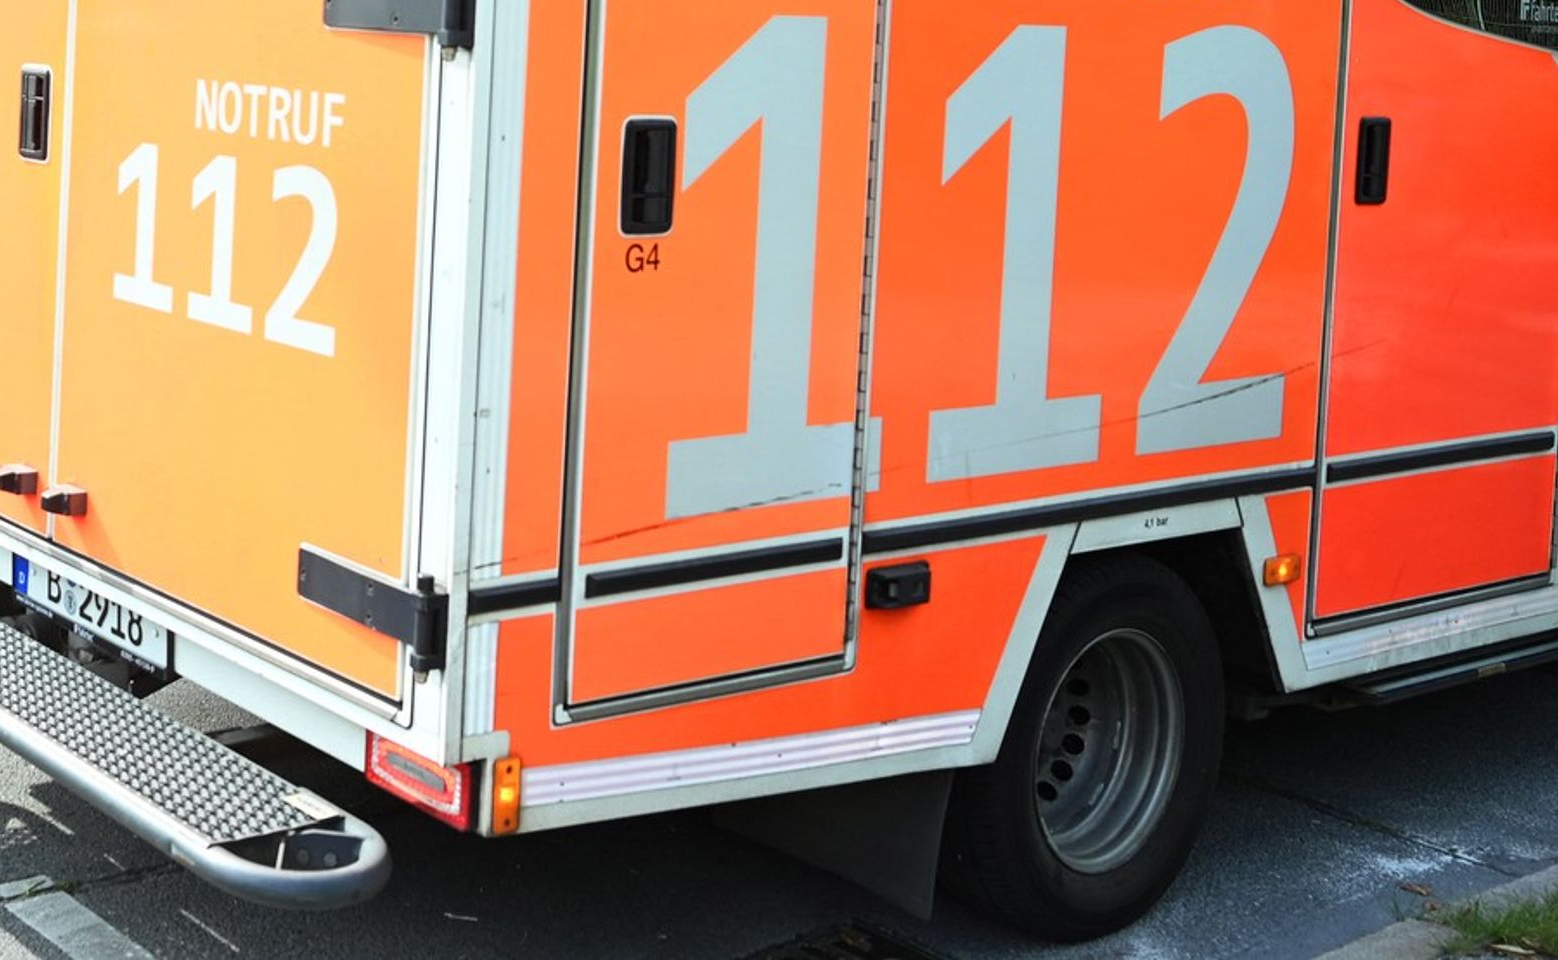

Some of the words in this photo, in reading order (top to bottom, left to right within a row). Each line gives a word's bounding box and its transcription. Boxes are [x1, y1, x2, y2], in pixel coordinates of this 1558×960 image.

[194, 78, 346, 148] NOTRUF
[112, 142, 338, 358] 112
[625, 242, 661, 273] G4
[664, 14, 1295, 521] 112
[1156, 517, 1169, 528] bar
